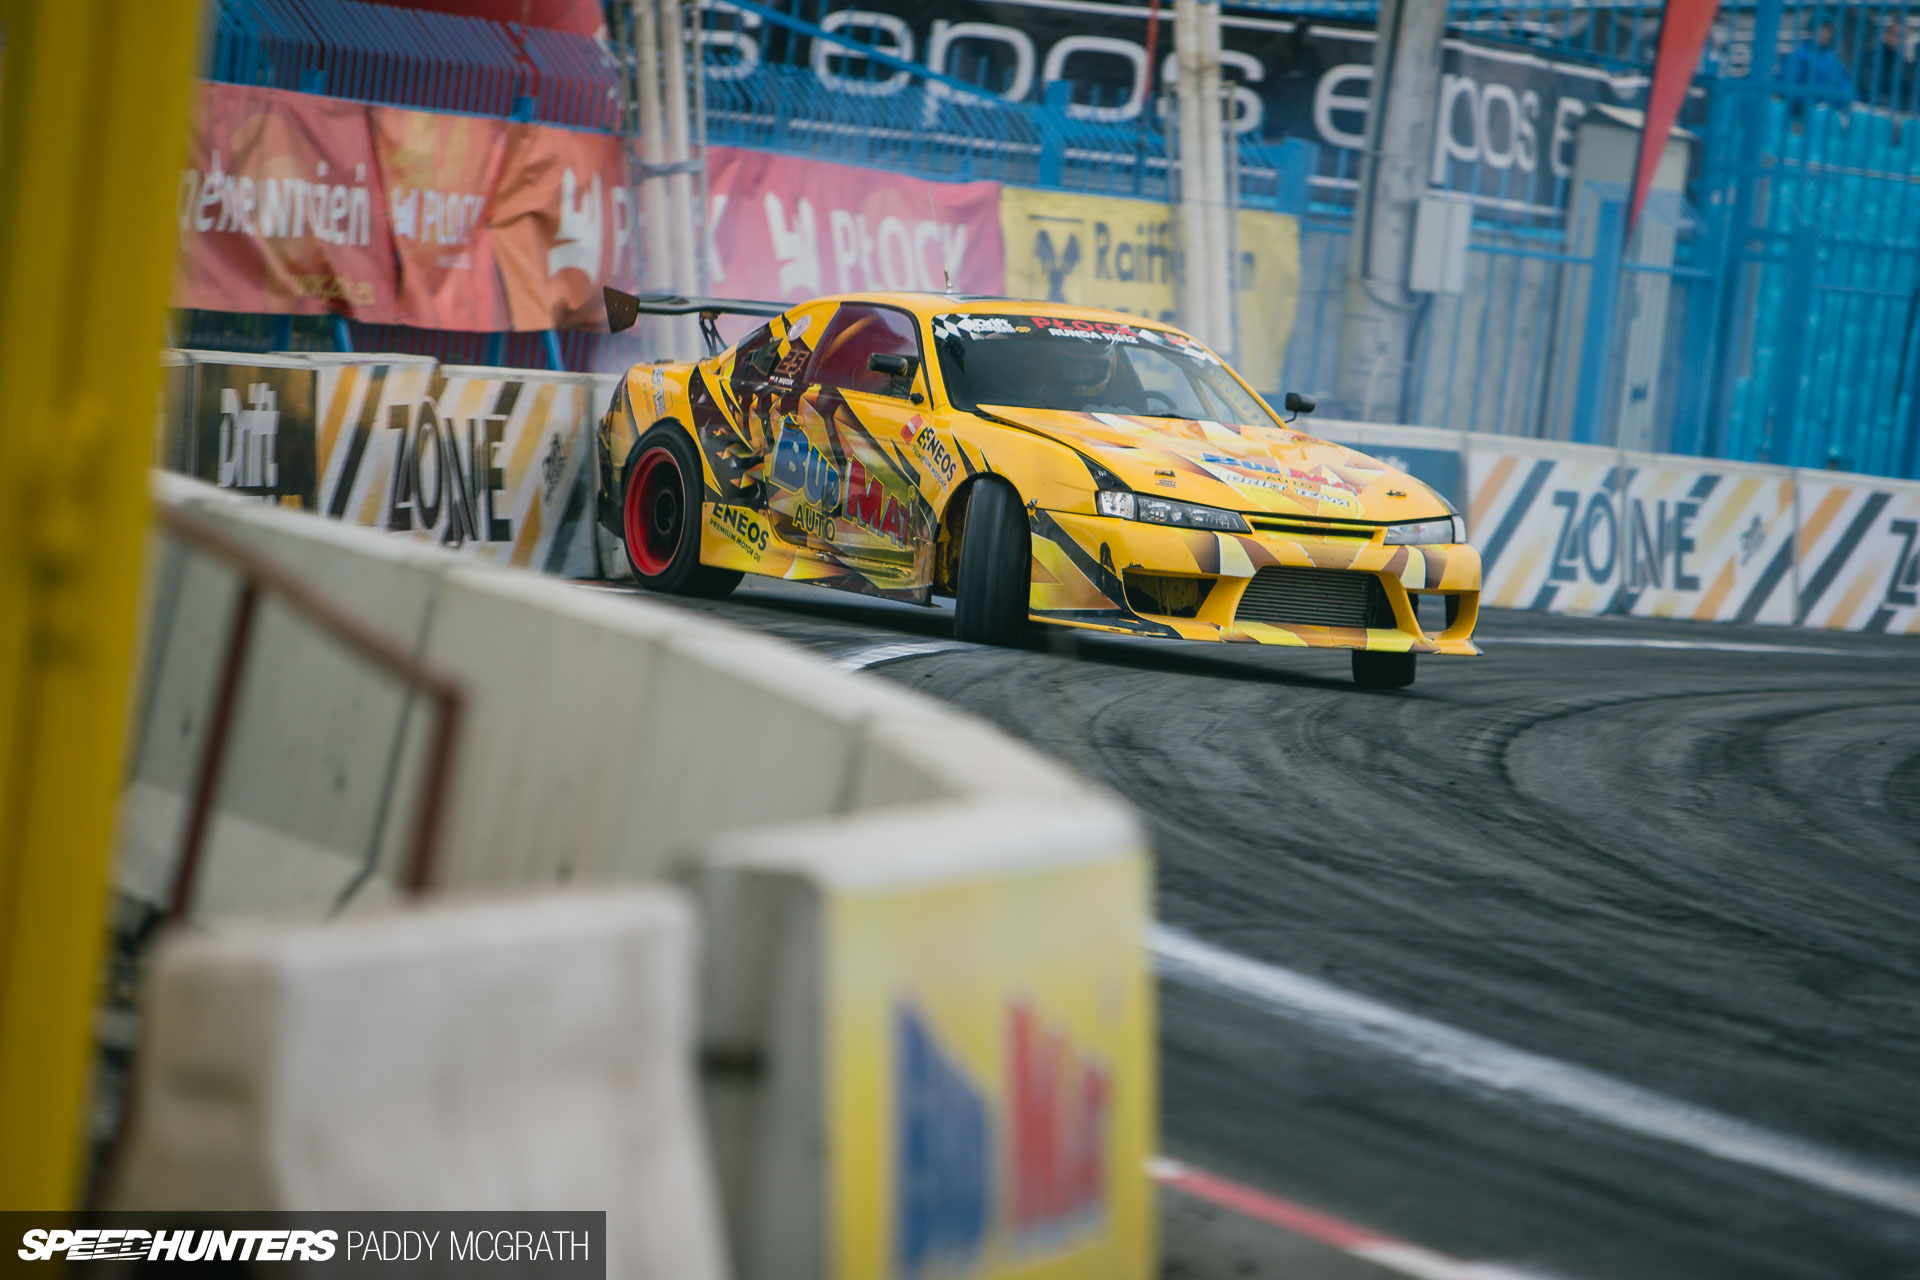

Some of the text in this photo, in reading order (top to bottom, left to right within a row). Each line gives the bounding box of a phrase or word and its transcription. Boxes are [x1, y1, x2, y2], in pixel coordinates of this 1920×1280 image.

[829, 205, 968, 293] PŁOCK
[1093, 221, 1256, 291] Raiffn
[1031, 317, 1140, 338] PŁOCK
[1048, 328, 1102, 340] RUNDA
[217, 382, 280, 488] Drift
[917, 427, 957, 482] ENEOS
[386, 395, 514, 547] ZONE
[709, 518, 736, 543] PREMIUM
[736, 538, 754, 556] MOTOR
[712, 503, 769, 551] ENEOS
[792, 503, 836, 542] AUTO
[1548, 487, 1703, 593] ZONE
